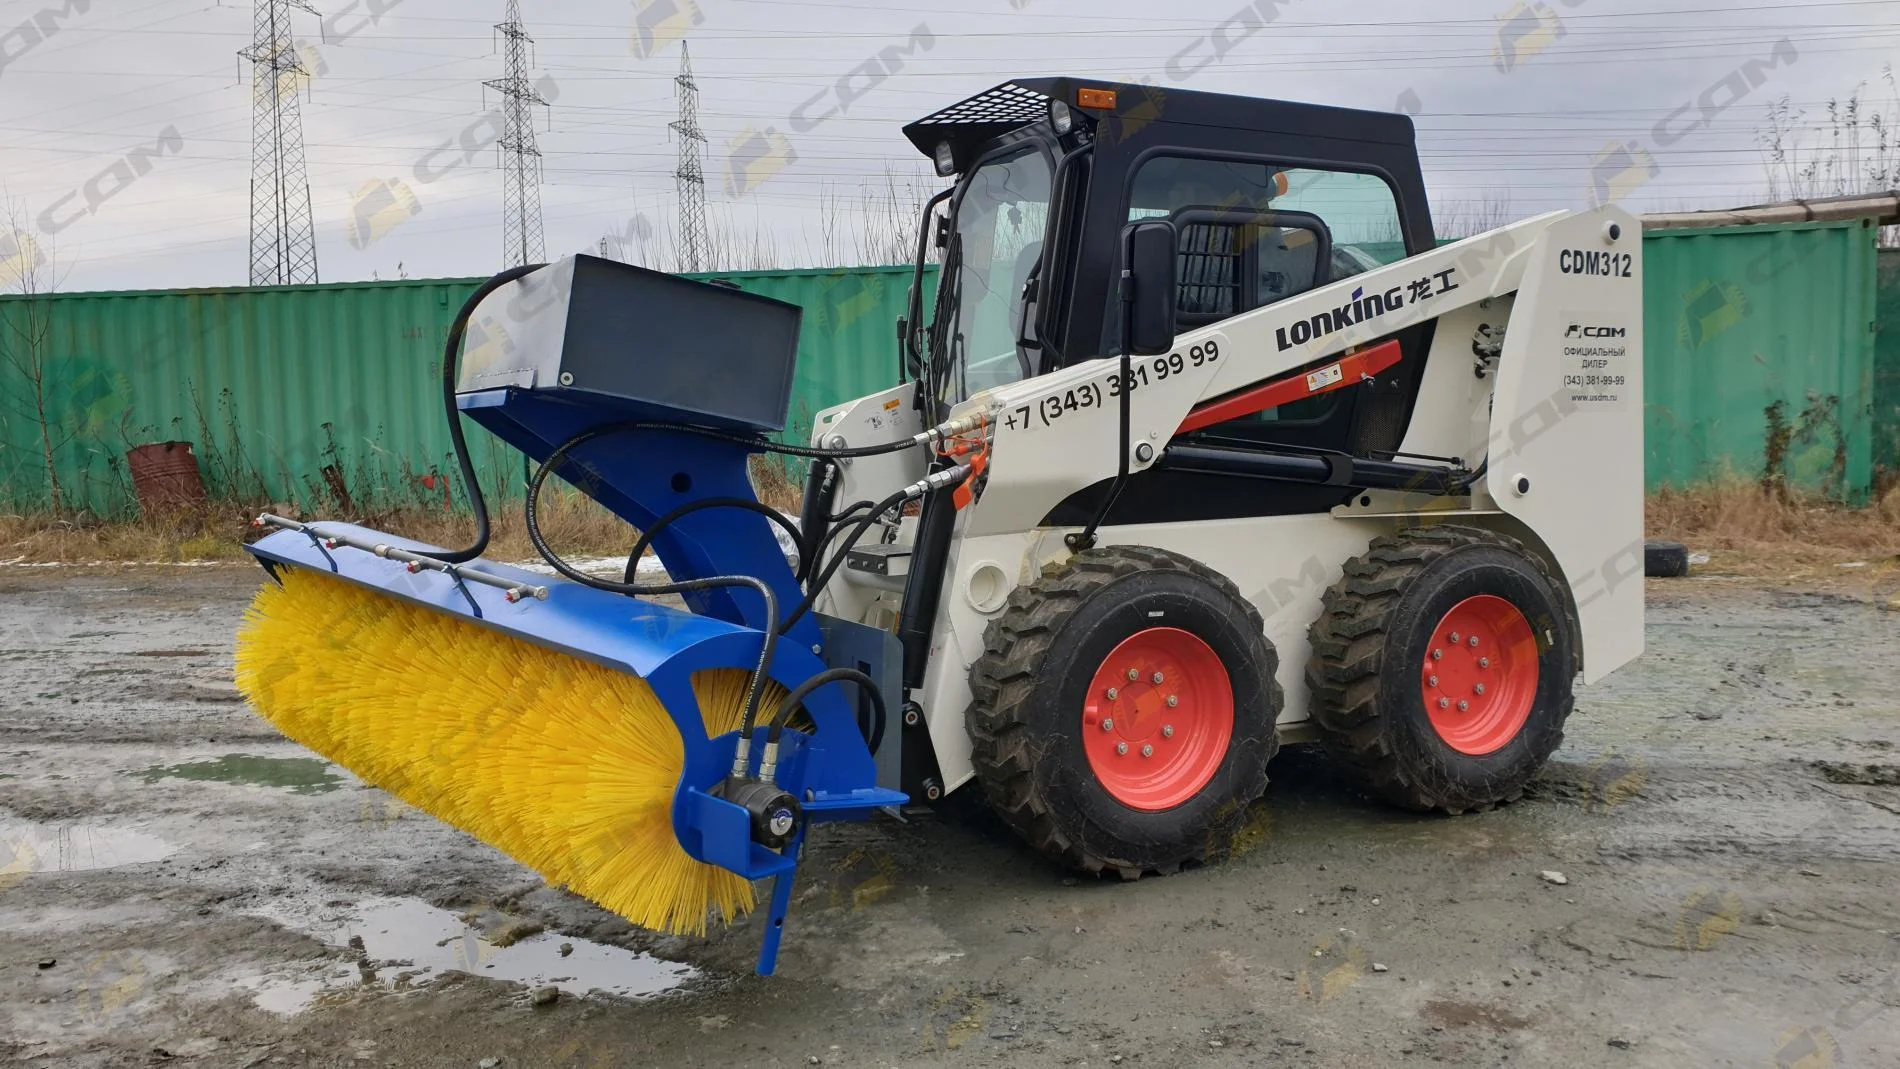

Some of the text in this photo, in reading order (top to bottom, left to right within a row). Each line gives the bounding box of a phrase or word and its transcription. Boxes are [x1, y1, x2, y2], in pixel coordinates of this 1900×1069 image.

[1560, 249, 1632, 278] CDM312
[1564, 346, 1626, 357] ОФИЦИАЛЬНЫЙ
[1581, 359, 1608, 369] ДИЛЕР
[1004, 405, 1030, 431] +7
[1040, 382, 1101, 427] (343)
[1153, 353, 1184, 380] 99
[1189, 340, 1219, 367] 99
[1563, 375, 1625, 387] (343) 381-99-99
[1571, 393, 1618, 402] www.usdm.ru
